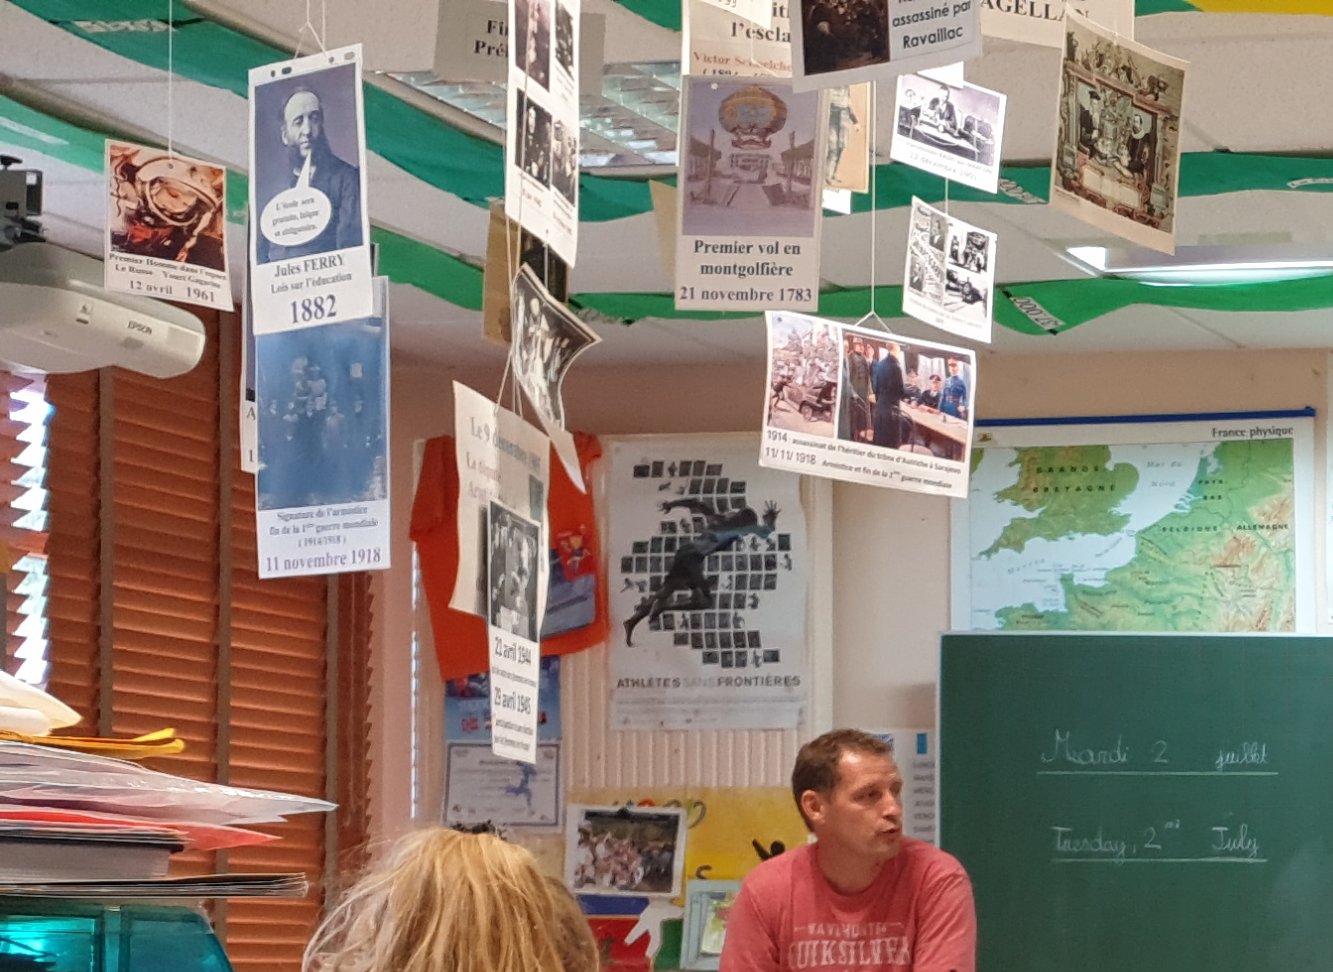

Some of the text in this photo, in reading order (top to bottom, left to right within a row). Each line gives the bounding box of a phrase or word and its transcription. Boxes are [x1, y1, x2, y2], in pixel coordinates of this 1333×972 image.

[892, 0, 971, 27] assassiné par
[731, 22, 791, 43] l'escla
[903, 25, 964, 49] Ravaillac
[693, 51, 729, 65] Victor
[694, 239, 801, 255] Premier vol en
[274, 254, 346, 278] Jules FERRY
[700, 261, 794, 279] montgolfière
[129, 280, 215, 302] 12 avril 1961
[271, 282, 289, 294] Lois
[305, 271, 352, 289] l'éducation
[680, 286, 812, 302] 21 novembre 1783
[291, 294, 337, 324] 1882
[128, 321, 153, 335] EPSON
[767, 430, 788, 443] 1914
[1212, 425, 1294, 438] France physique
[266, 548, 381, 572] 11 novembre 1918
[717, 674, 800, 688] FRONTIÈRES
[1041, 729, 1268, 769] Mardi 2 juillet
[1211, 824, 1260, 862] July
[788, 936, 912, 969] QUIKSILVER
